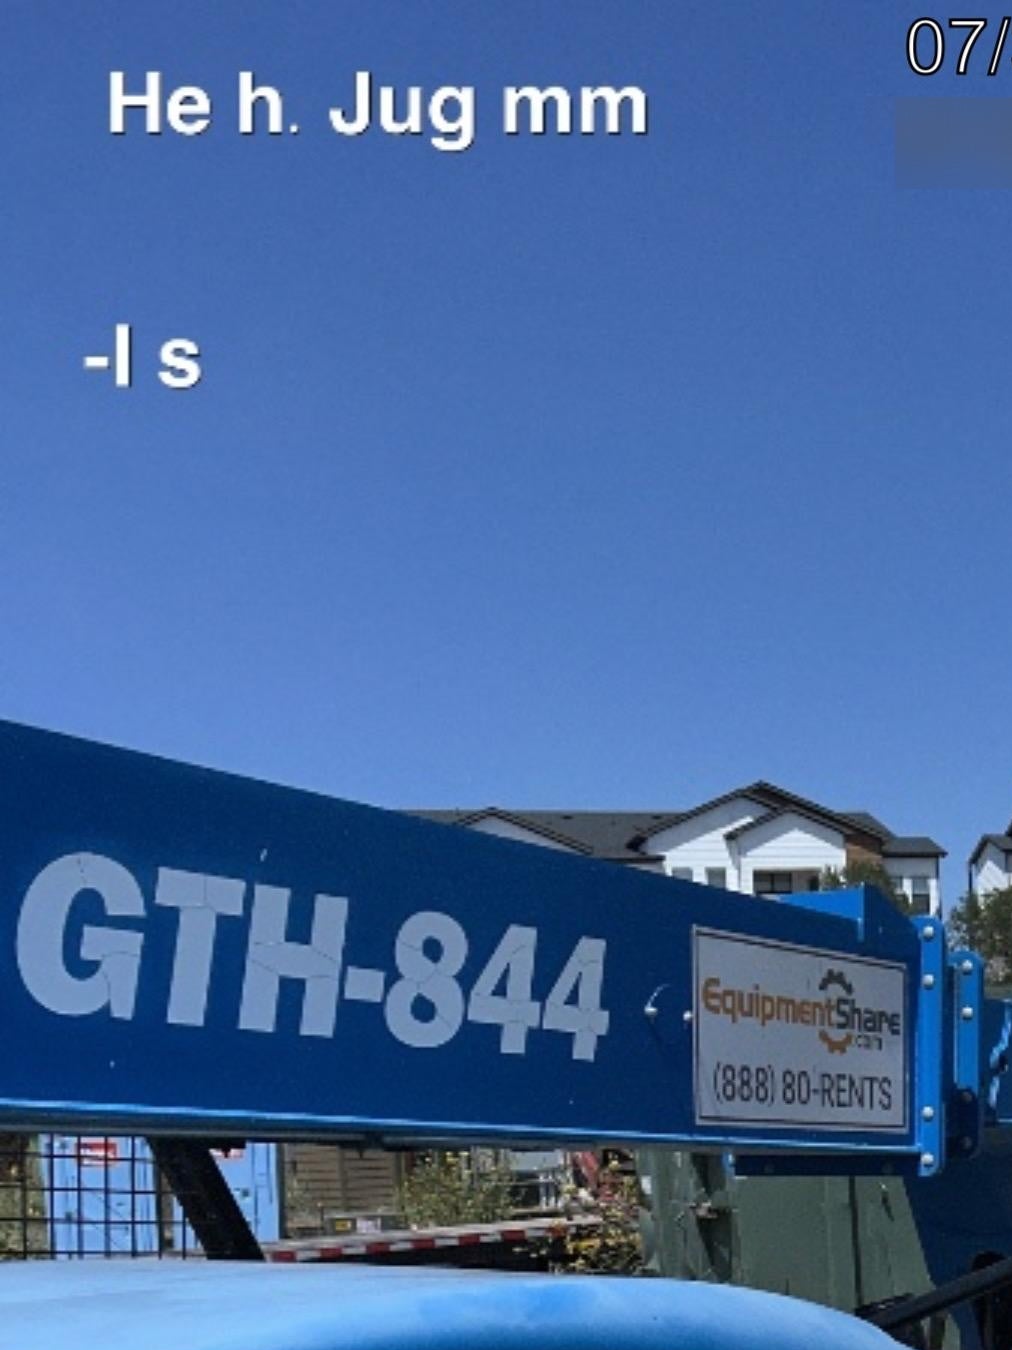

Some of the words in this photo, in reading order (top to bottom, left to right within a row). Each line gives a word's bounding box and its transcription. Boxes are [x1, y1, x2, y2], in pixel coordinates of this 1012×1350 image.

[16, 851, 610, 1063] GTH-844
[714, 1060, 776, 1107] (888)
[782, 1069, 892, 1111] 80-RENTS
